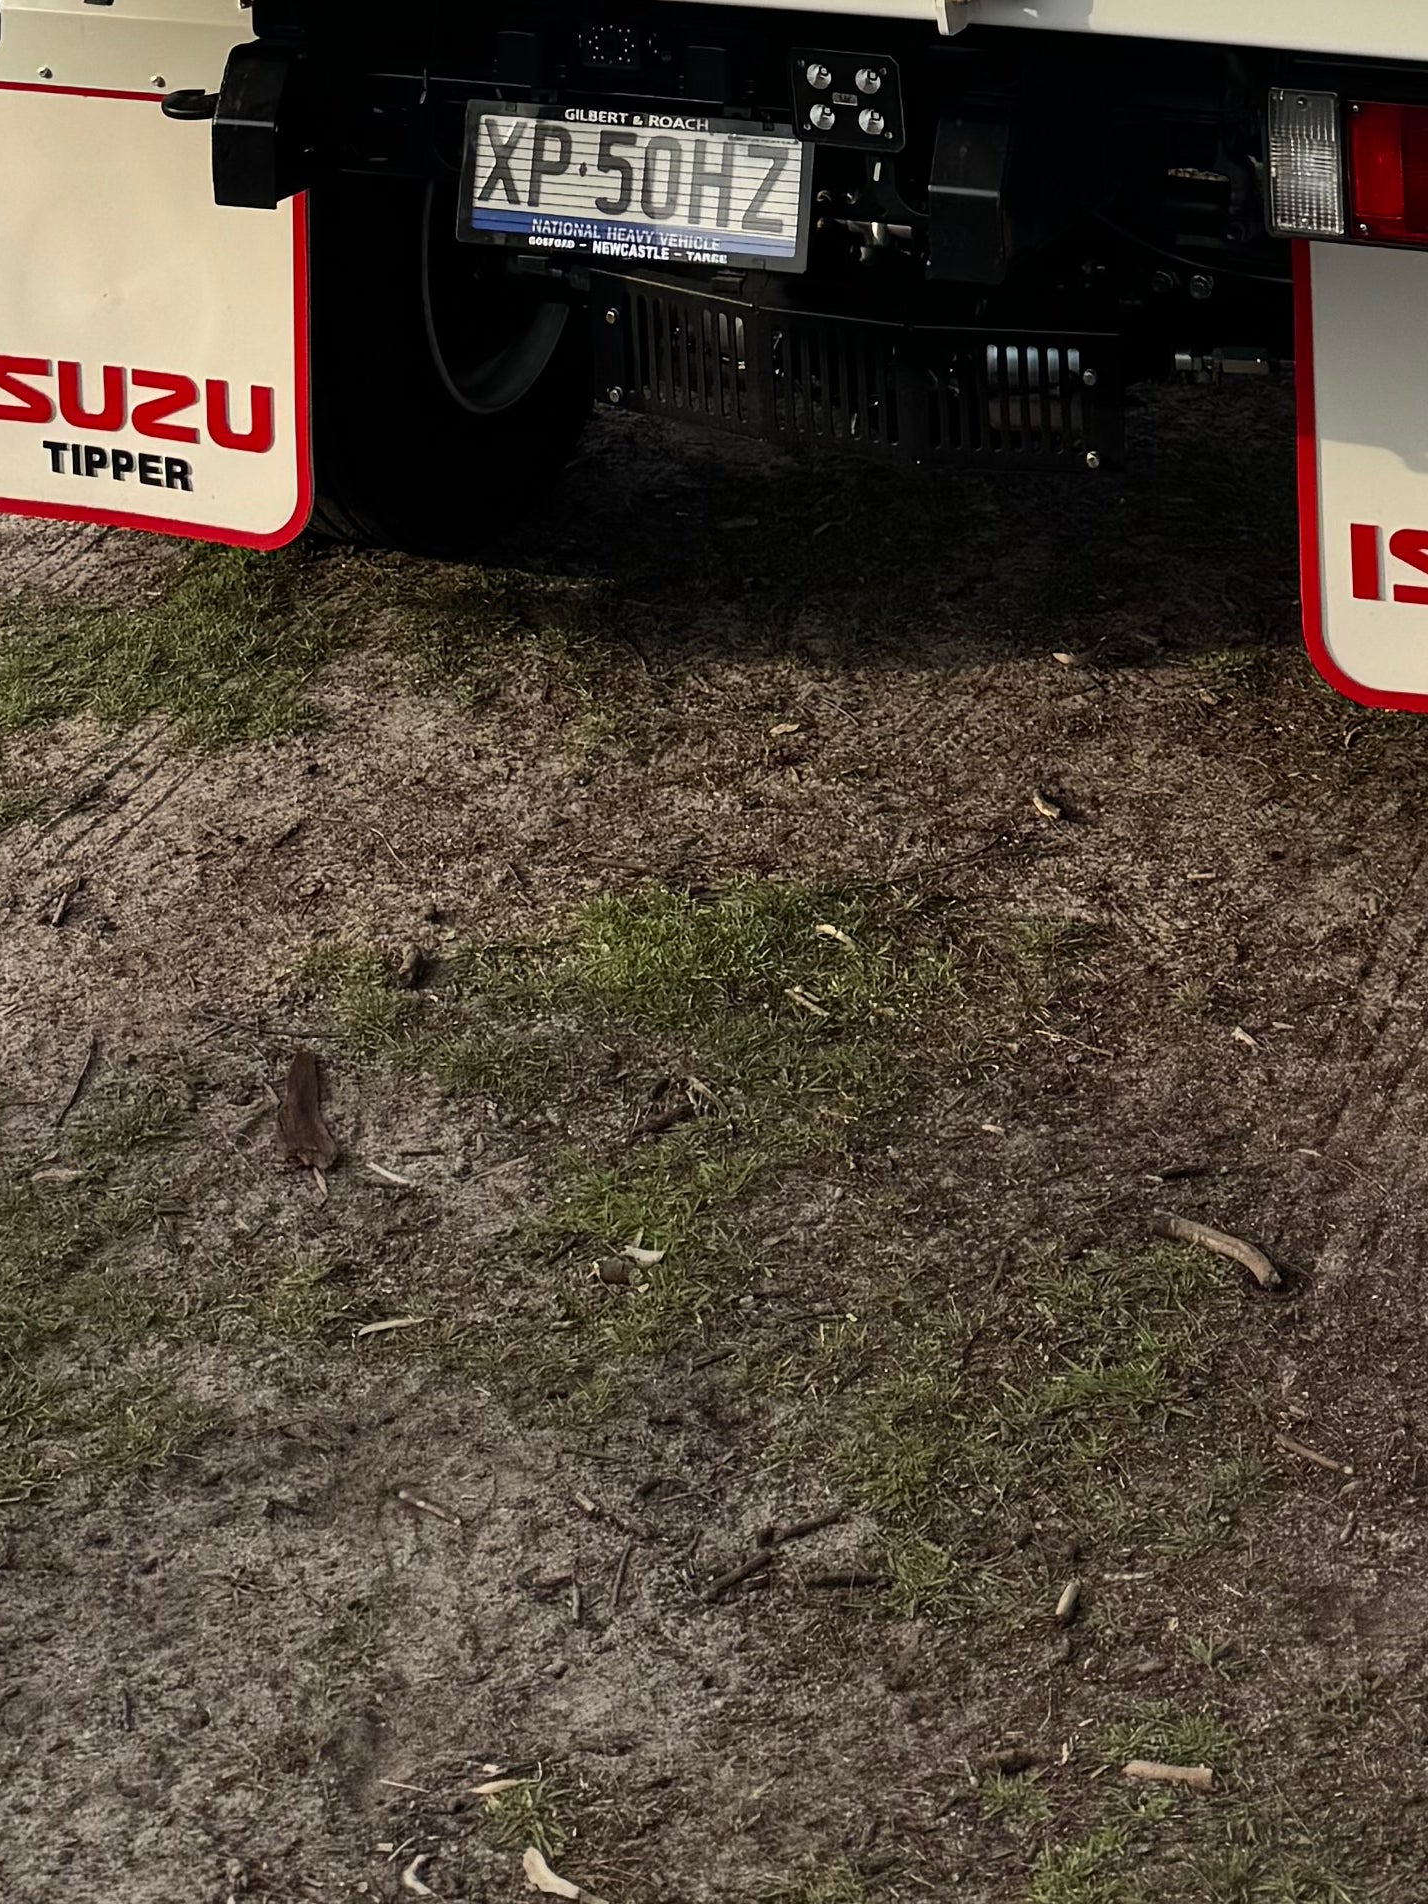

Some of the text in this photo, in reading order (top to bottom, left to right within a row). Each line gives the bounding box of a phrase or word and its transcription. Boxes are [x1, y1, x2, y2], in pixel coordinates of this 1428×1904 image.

[564, 108, 710, 132] GILBERT & ROACH
[528, 236, 576, 250] GOSFORD
[592, 241, 670, 261] NEWCASTLE
[686, 250, 728, 265] TAREE
[531, 218, 721, 252] NATIONAL HEAVY VEHICLE
[42, 440, 194, 492] TIPPER
